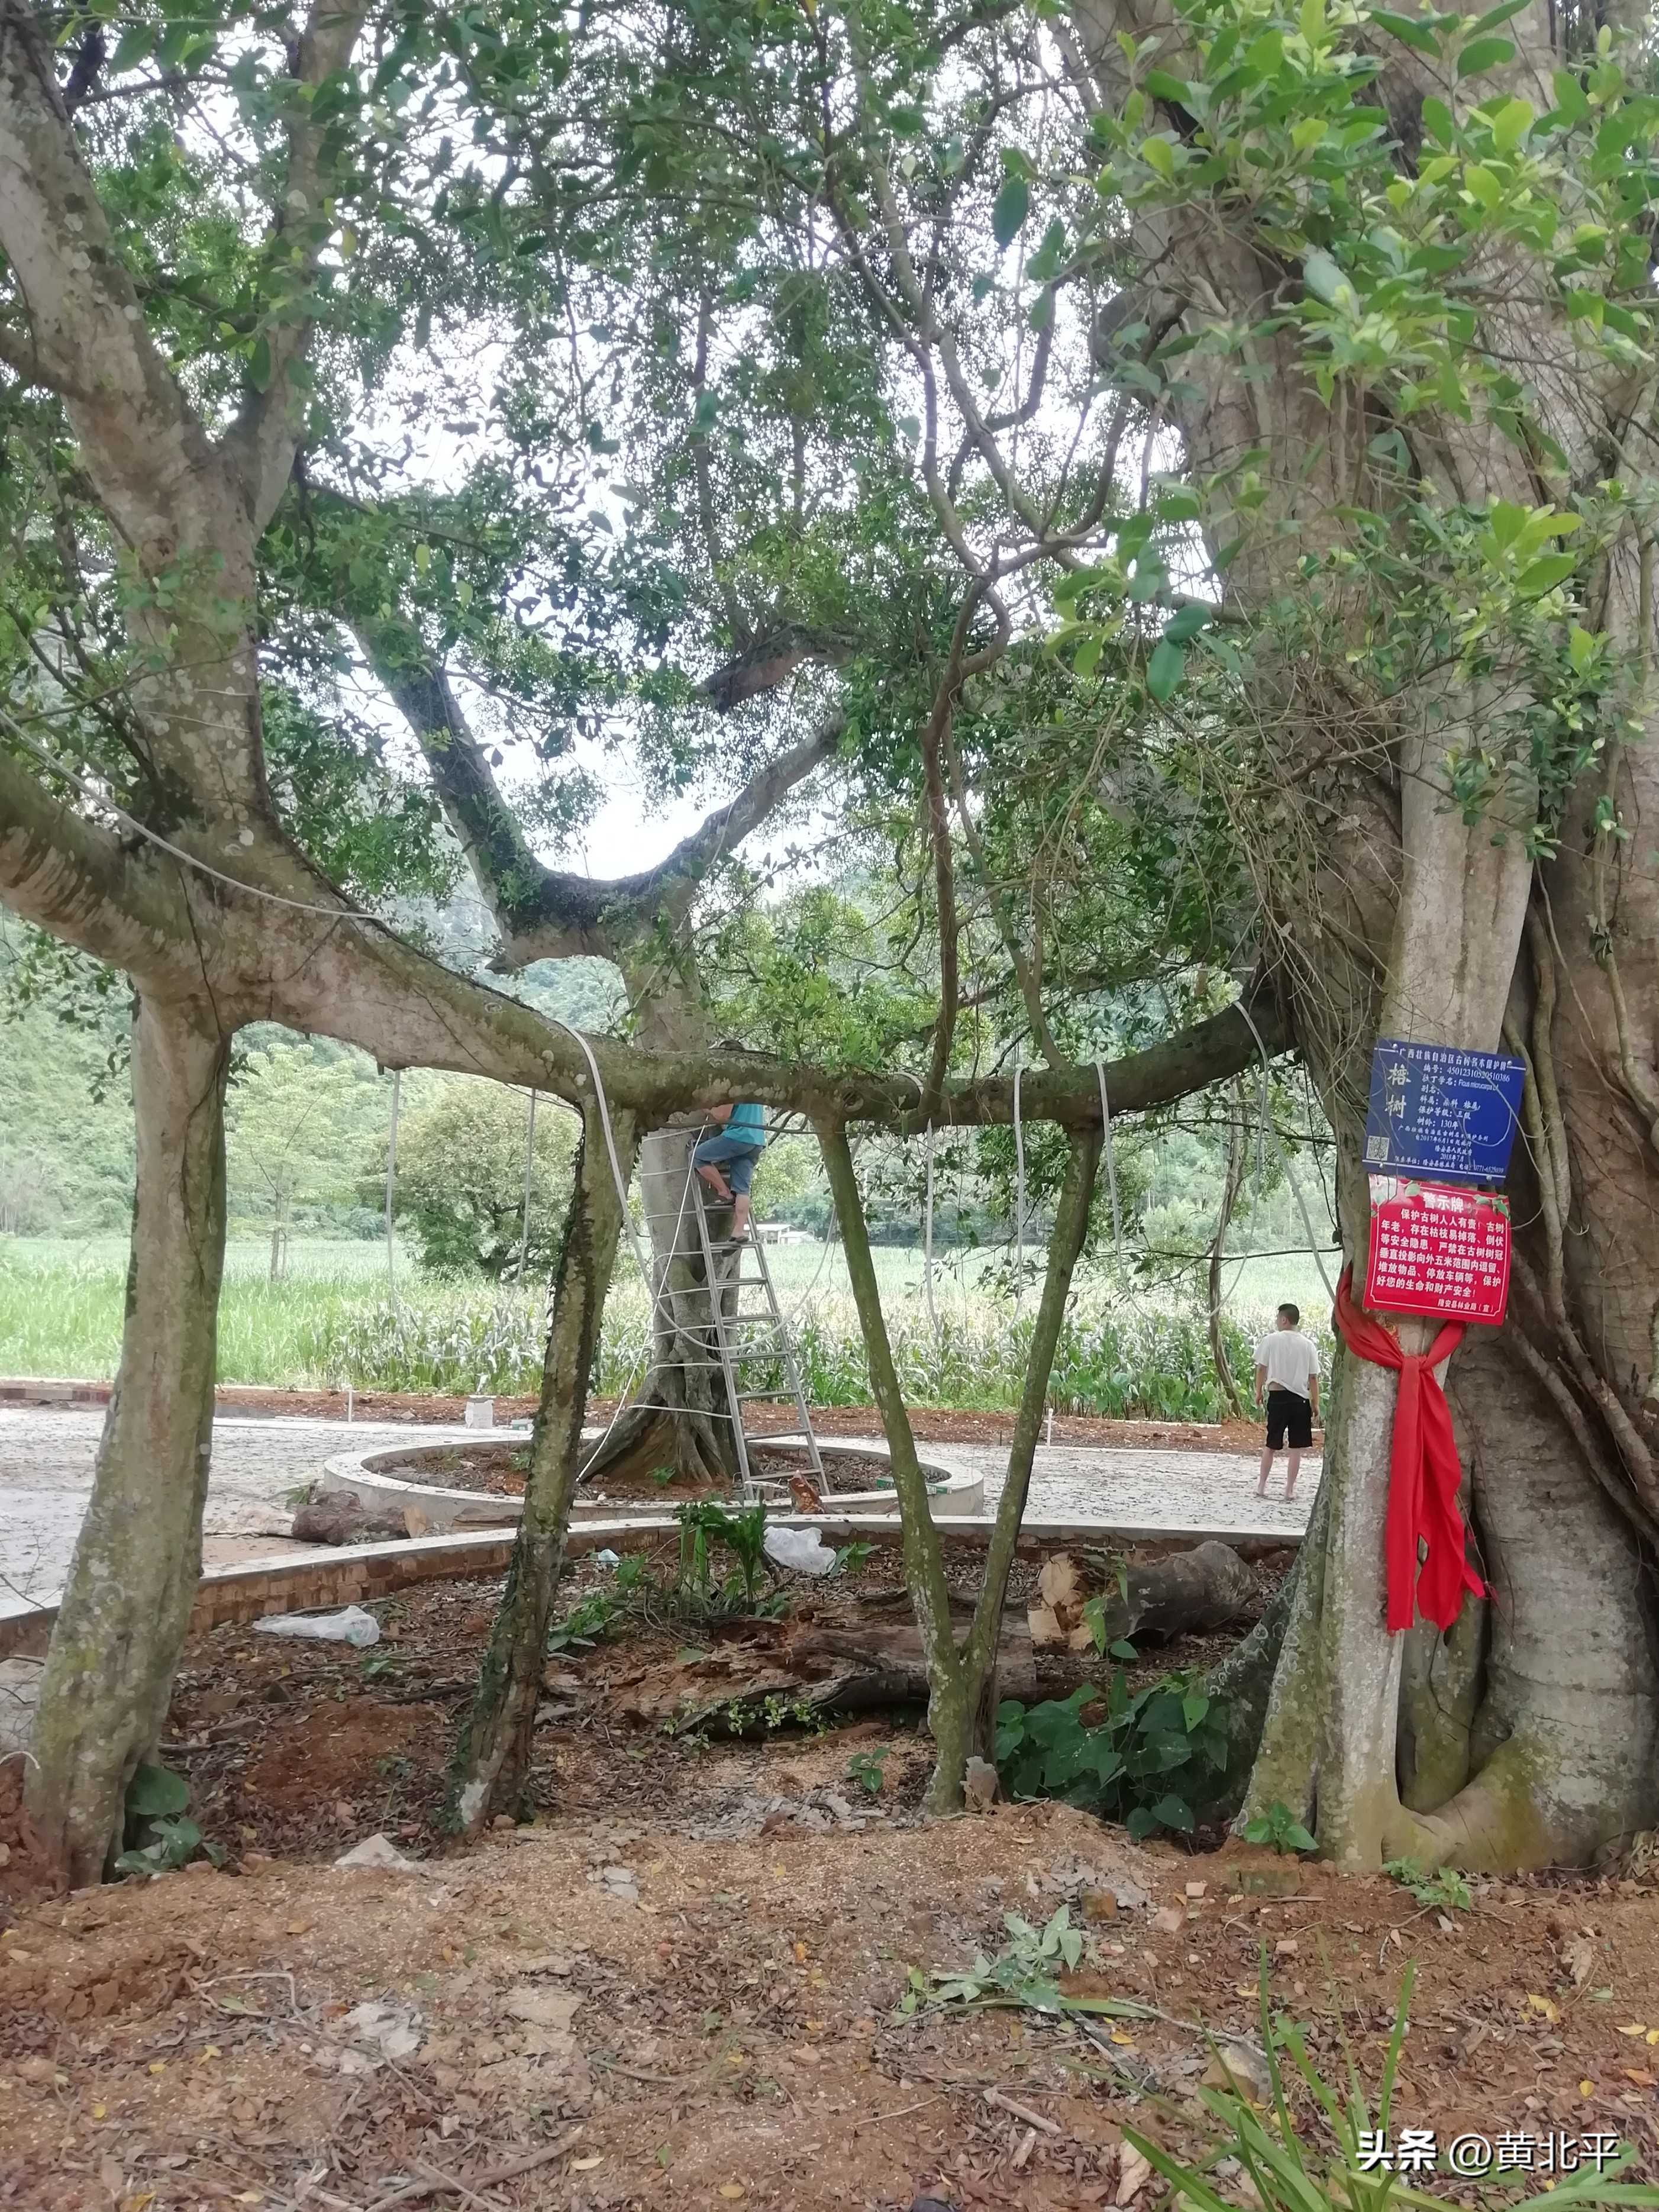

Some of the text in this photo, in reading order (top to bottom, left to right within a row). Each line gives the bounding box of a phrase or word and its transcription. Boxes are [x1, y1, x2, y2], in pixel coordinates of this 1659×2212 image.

[1399, 1049, 1507, 1070] 广西壮族自治区古树名木保护牌
[1384, 1063, 1411, 1119] 榕树
[1423, 1192, 1464, 1213] 警示牌
[1376, 1275, 1476, 1298] 好您的生命和财产安全！
